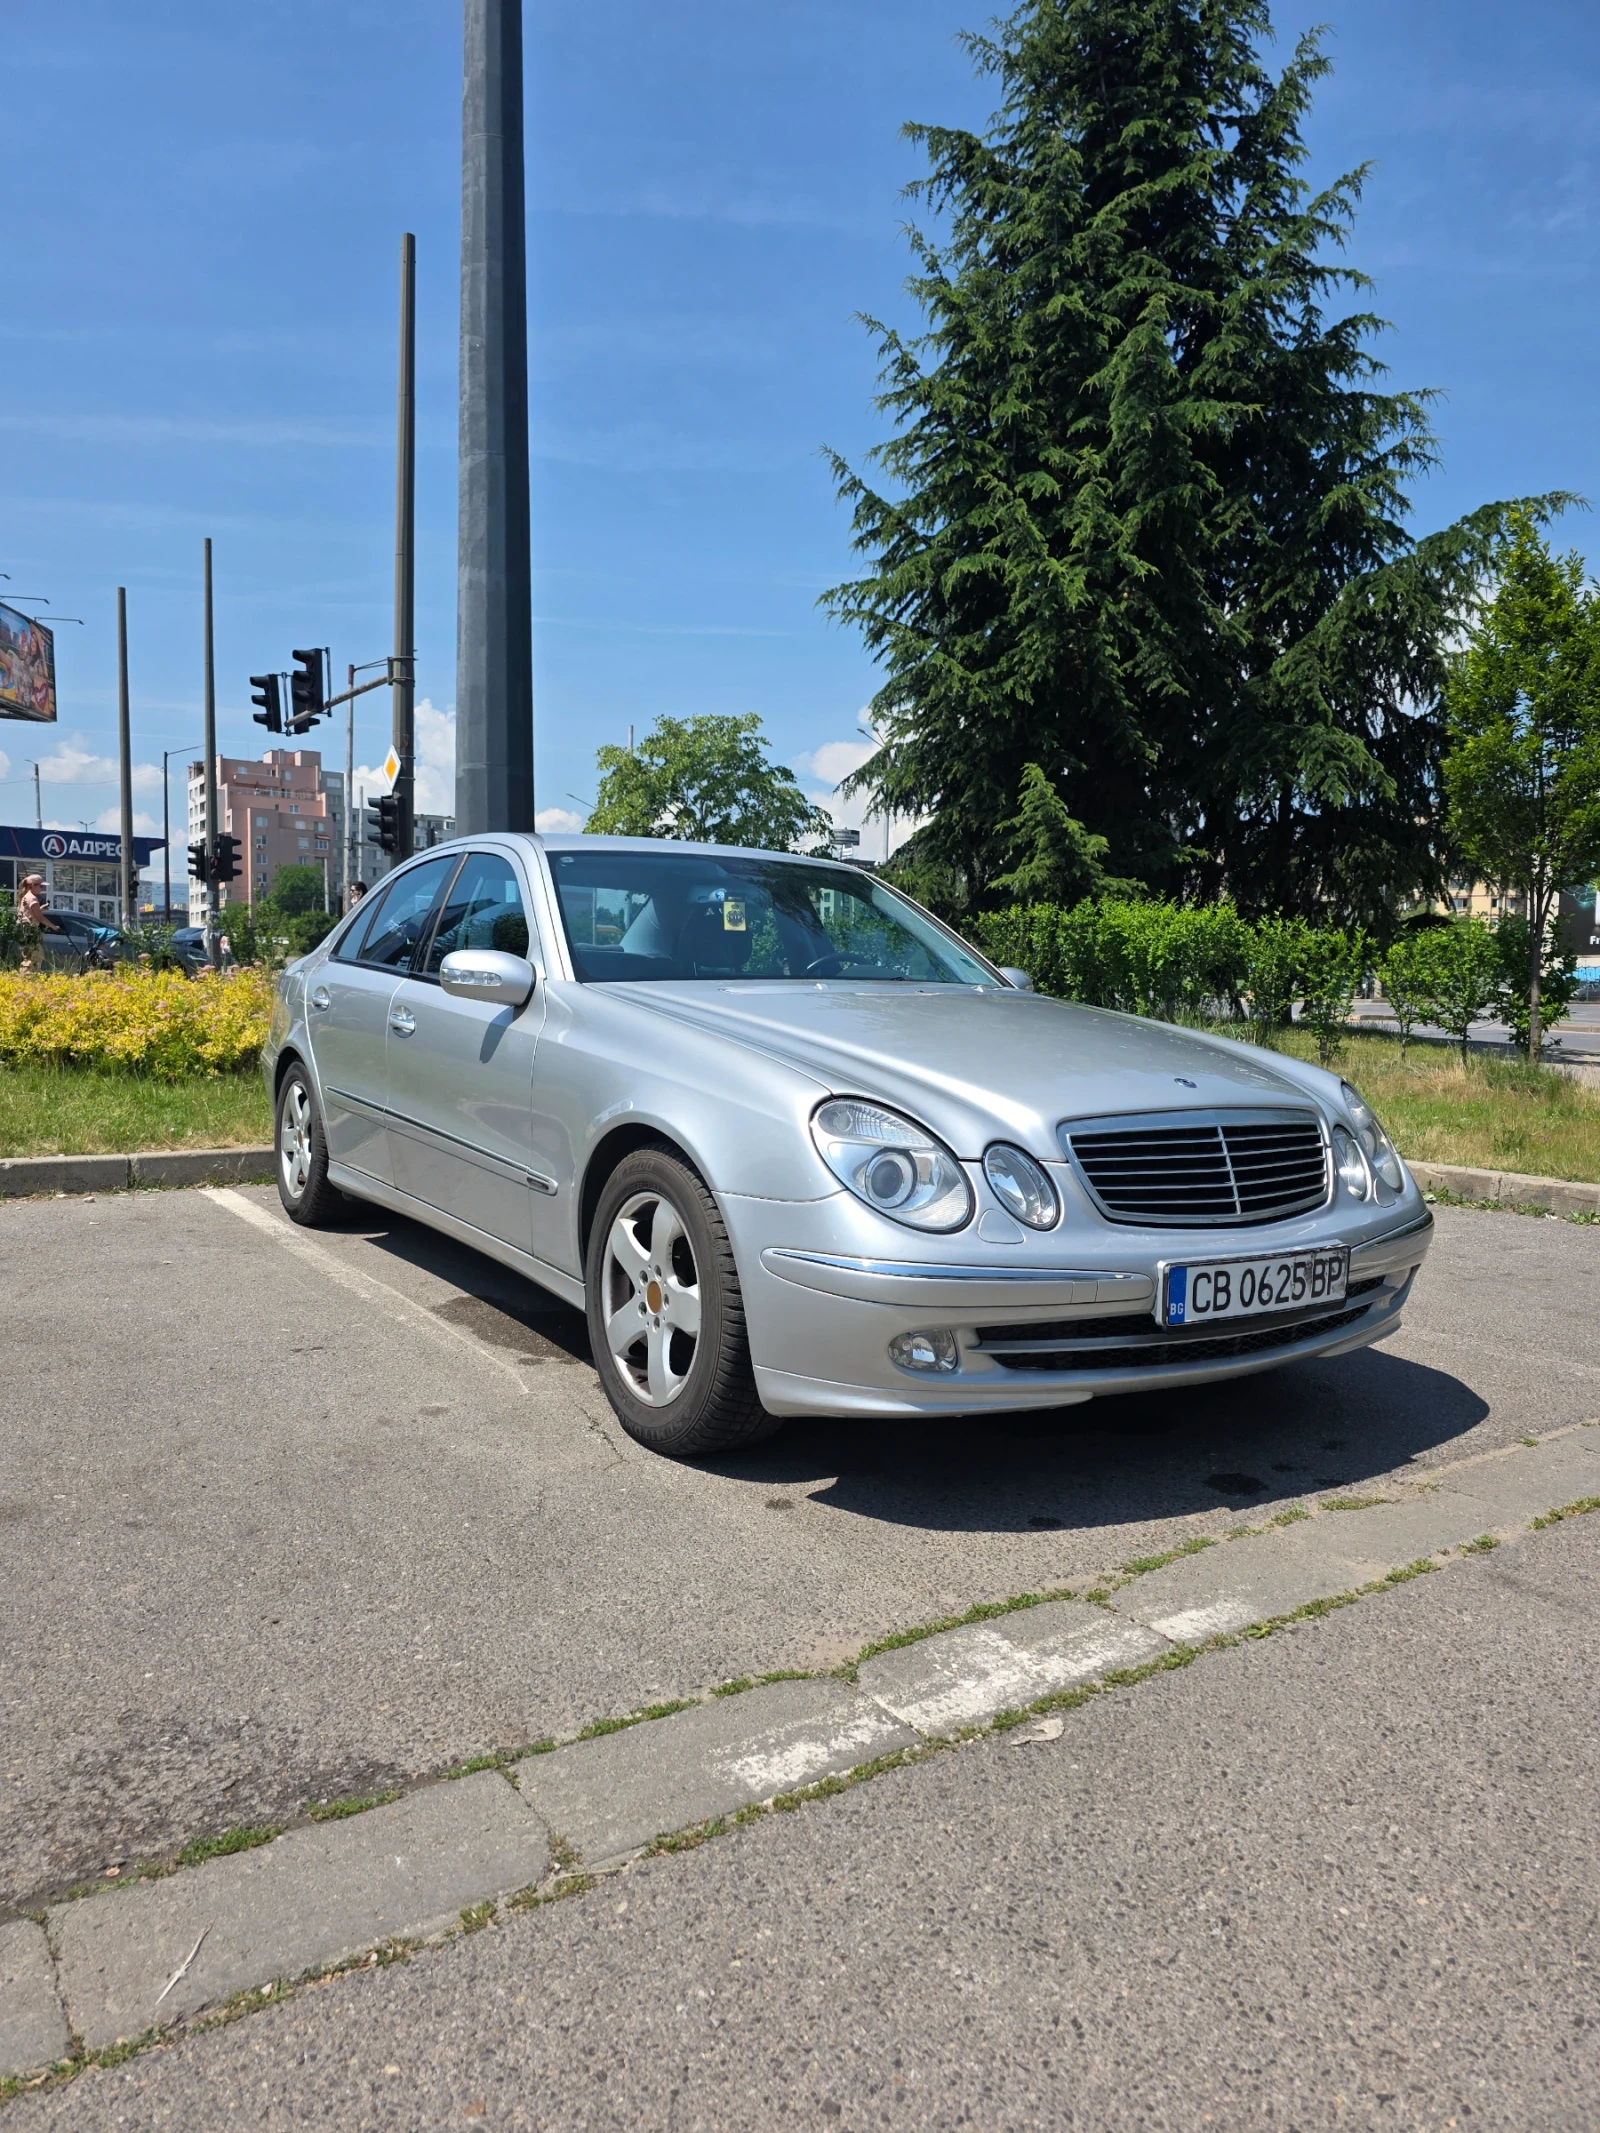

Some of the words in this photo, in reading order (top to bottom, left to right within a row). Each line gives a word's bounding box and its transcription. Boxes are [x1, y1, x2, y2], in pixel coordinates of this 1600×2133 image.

[1192, 1270, 1232, 1314] CB
[1240, 1261, 1307, 1308] 0625
[1311, 1256, 1344, 1299] BP
[1170, 1303, 1184, 1316] BG
